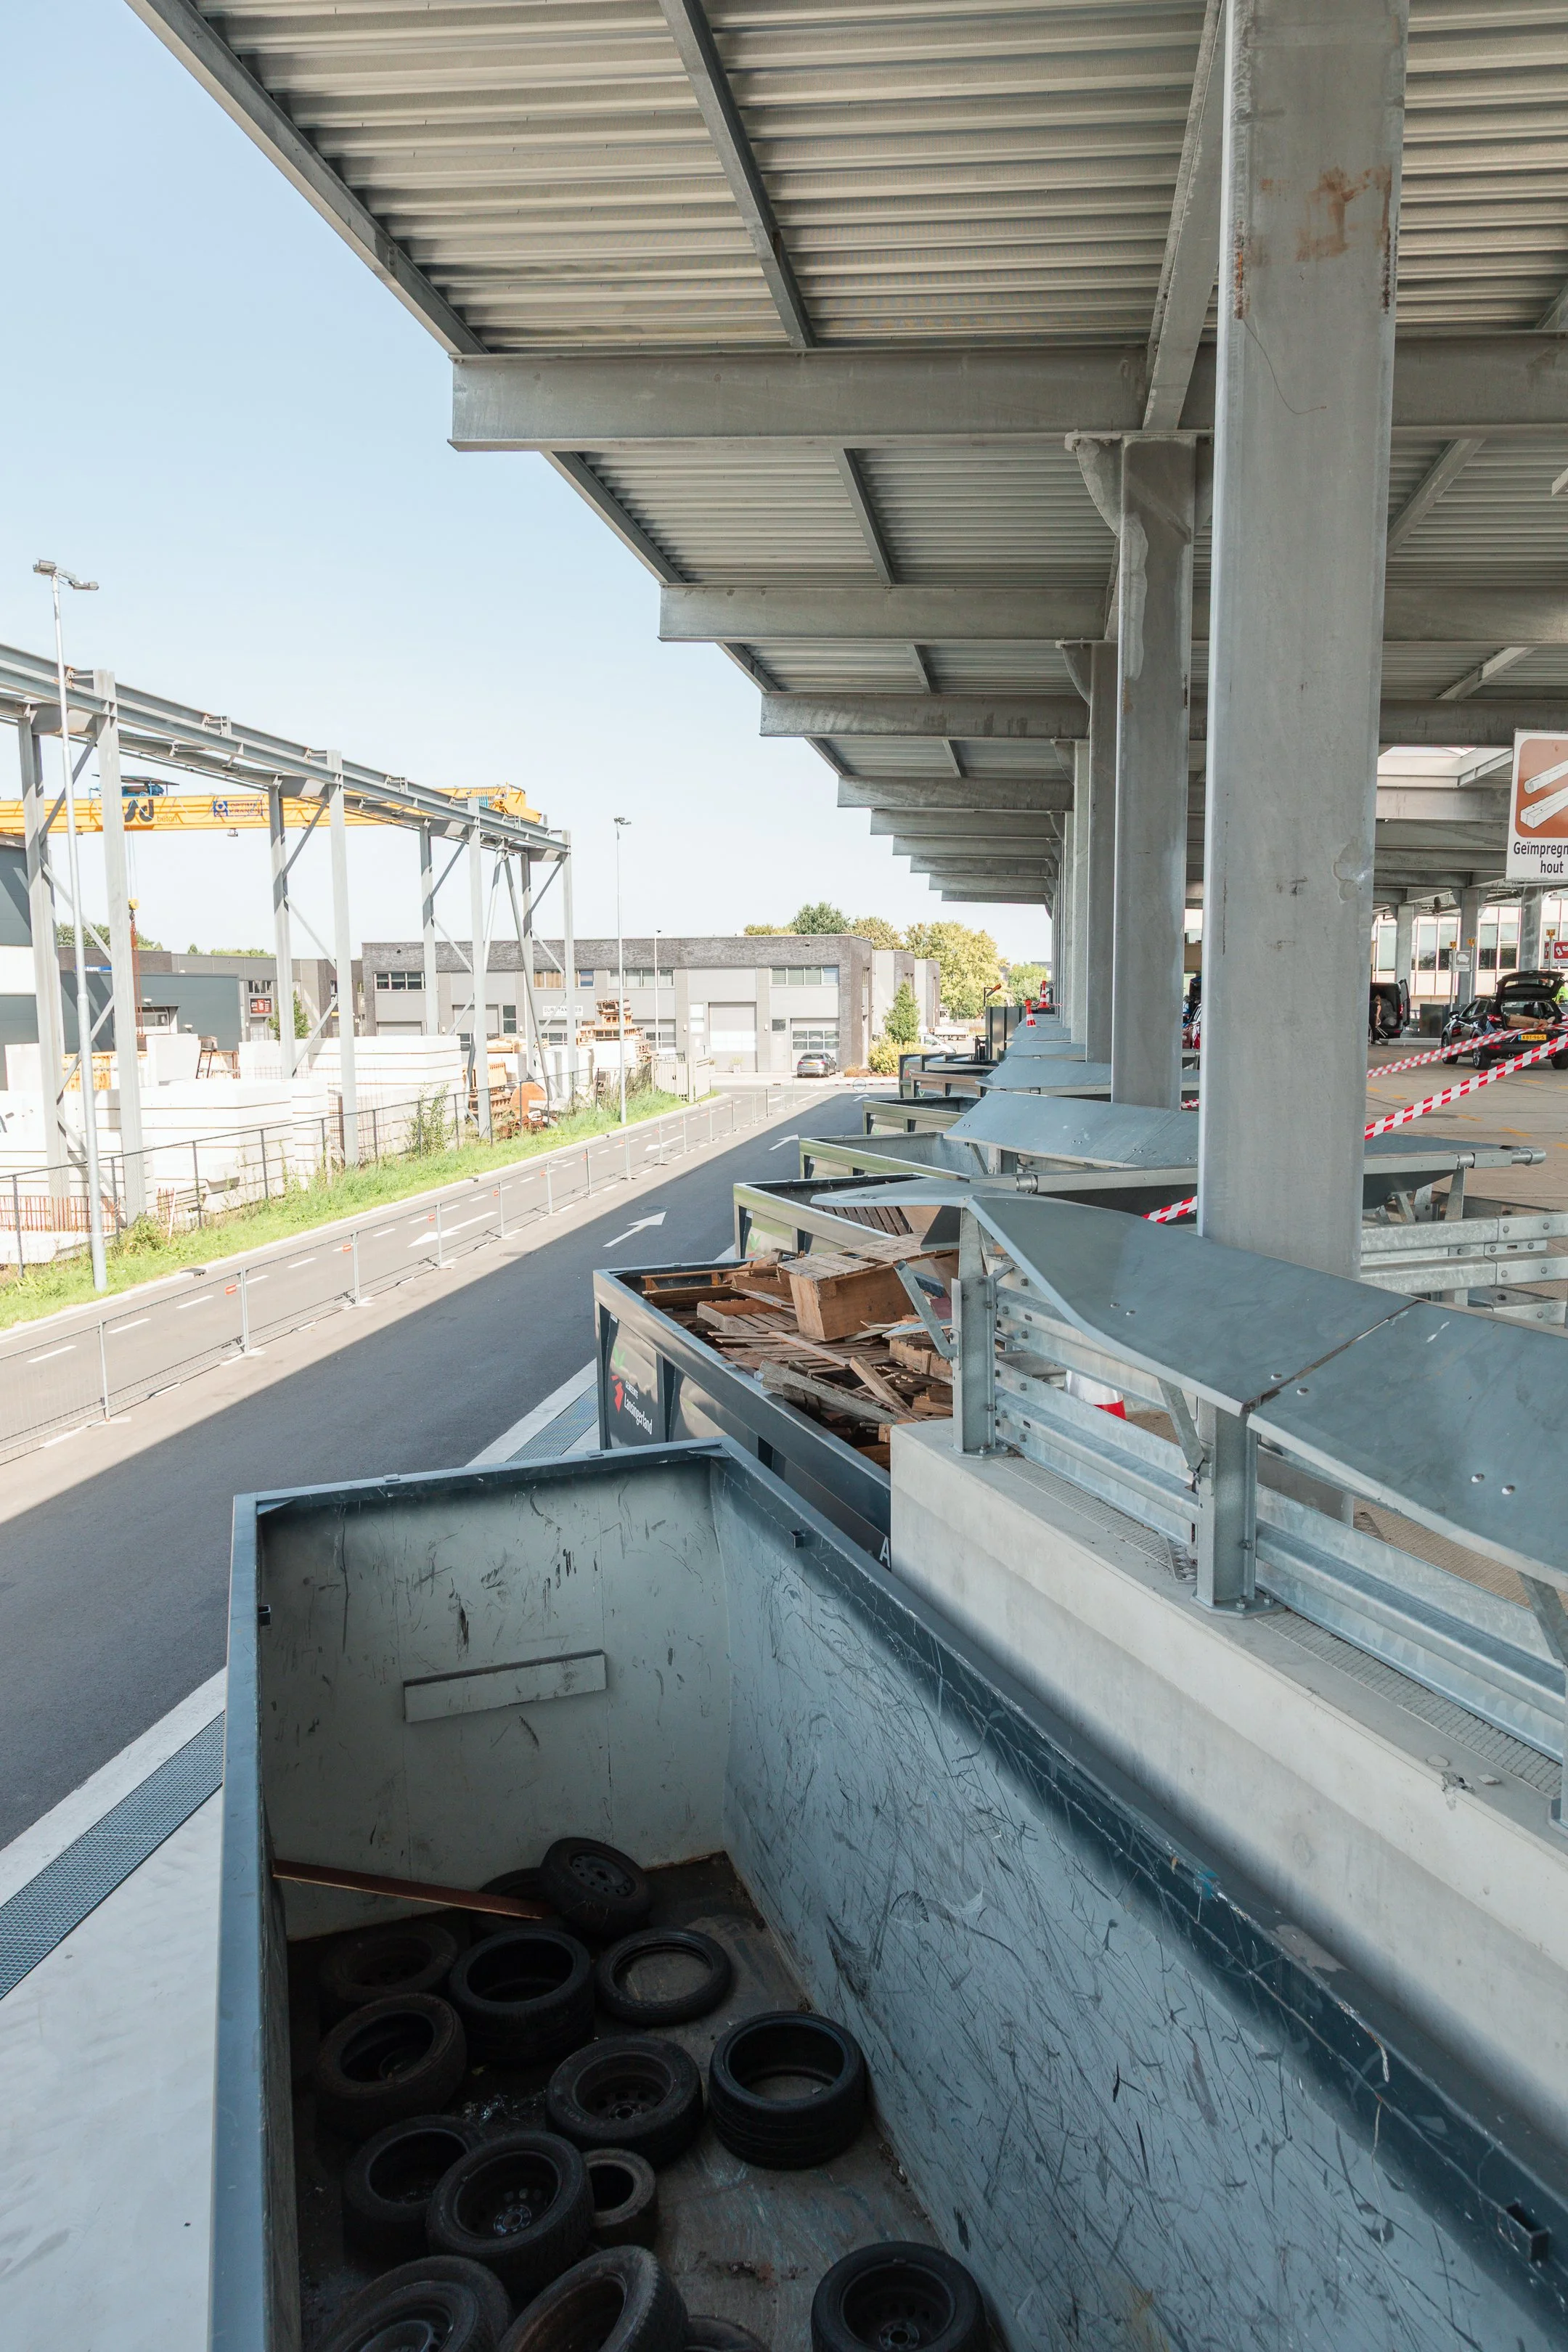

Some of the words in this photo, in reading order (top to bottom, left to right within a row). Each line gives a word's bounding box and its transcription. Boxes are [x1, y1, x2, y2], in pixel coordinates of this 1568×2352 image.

[1540, 860, 1564, 873] hout
[626, 1381, 638, 1399] GEMEENTE
[624, 1393, 652, 1434] Lansingerland
